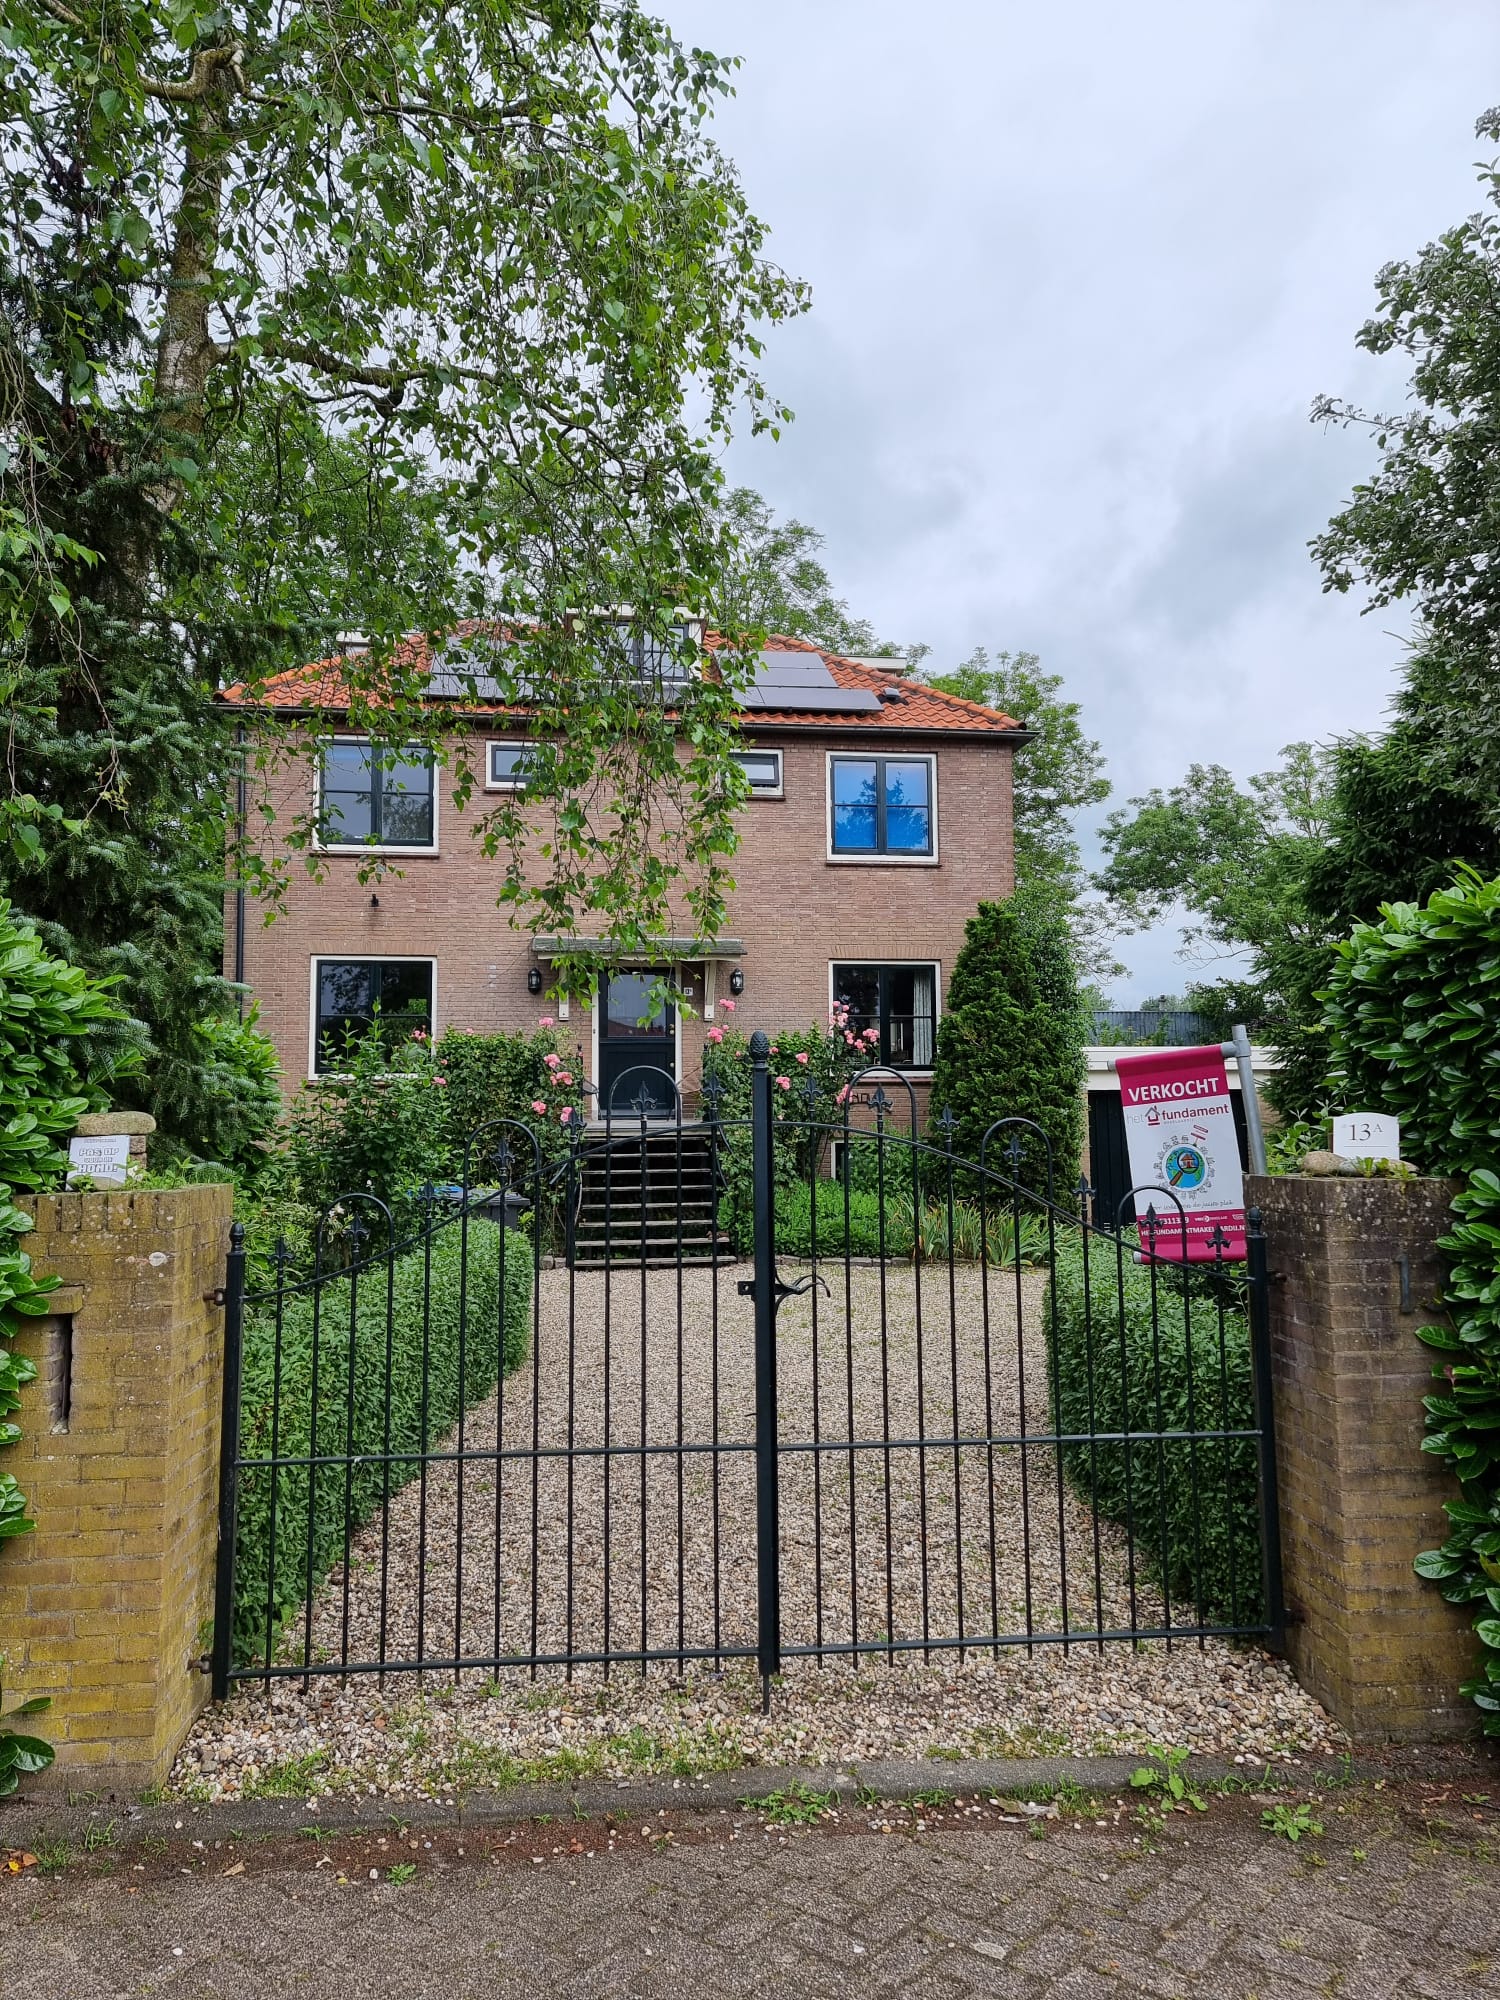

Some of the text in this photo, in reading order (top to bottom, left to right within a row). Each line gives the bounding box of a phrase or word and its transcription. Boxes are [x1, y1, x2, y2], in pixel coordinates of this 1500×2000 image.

[1128, 1077, 1219, 1102] VERKOCHT
[1126, 1114, 1145, 1125] het
[1162, 1104, 1229, 1120] fundament
